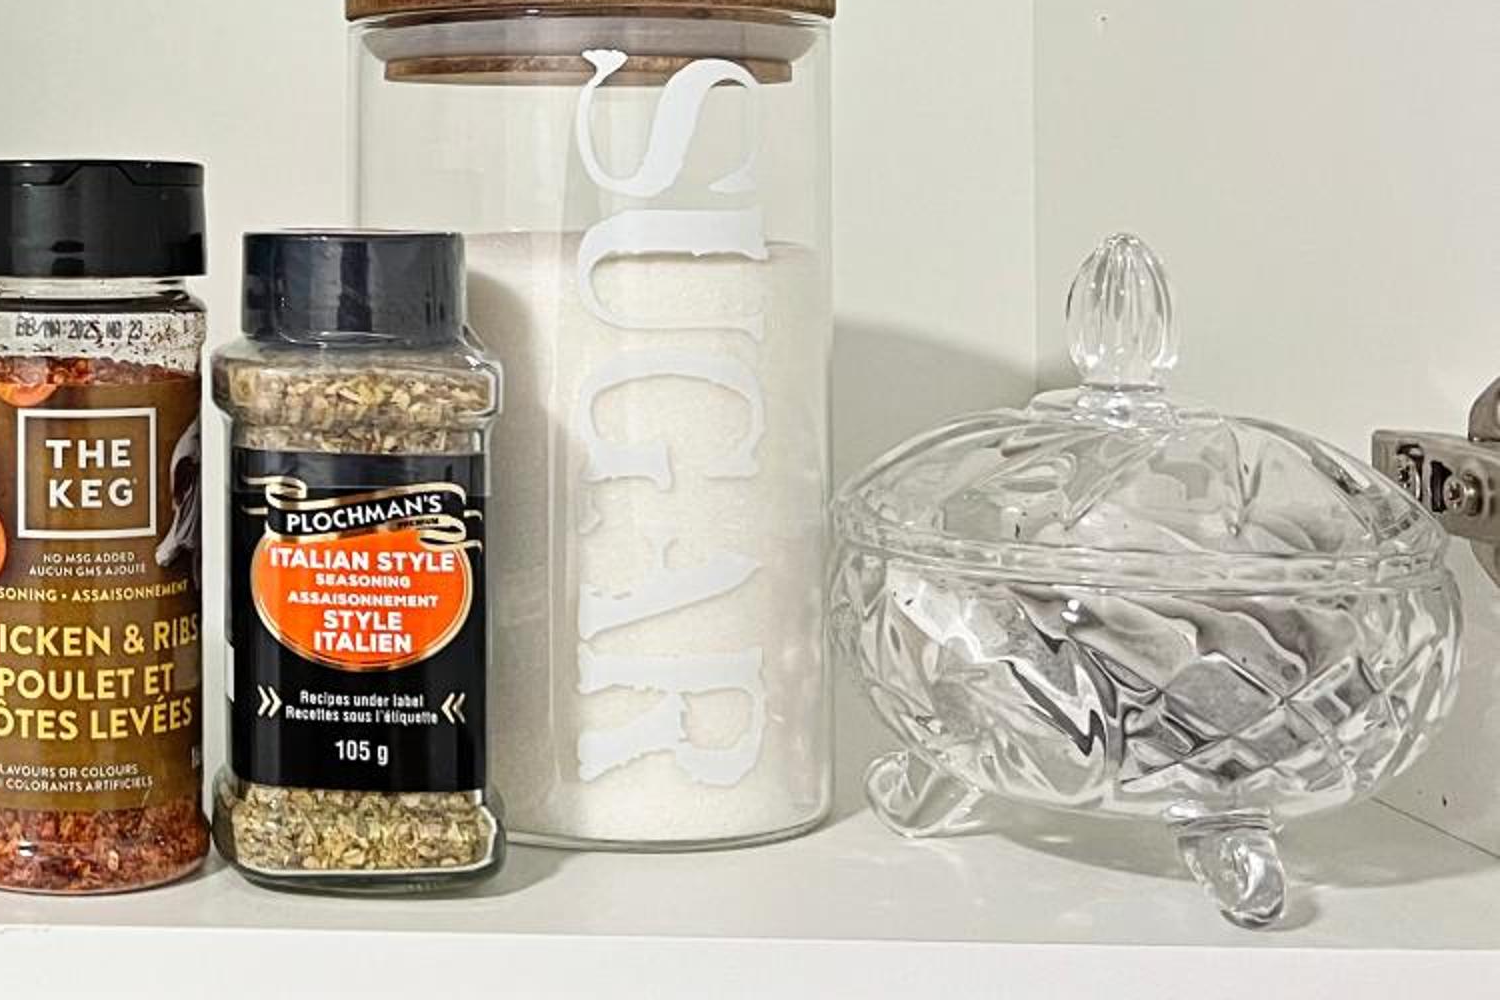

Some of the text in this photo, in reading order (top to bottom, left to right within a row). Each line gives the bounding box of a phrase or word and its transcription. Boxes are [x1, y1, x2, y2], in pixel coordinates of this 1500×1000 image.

[575, 48, 769, 789] SUGAR
[45, 439, 132, 469] THE
[48, 478, 134, 509] KEG
[285, 495, 443, 533] PLOCHMAN'S
[43, 551, 135, 564] NO MSG ADDED
[269, 546, 455, 573] ITALIAN STYLE
[28, 565, 73, 577] AUCUN
[75, 565, 101, 577] GMS
[314, 573, 411, 589] SEASONING
[71, 577, 188, 603] ASSAISONNEMENT
[287, 591, 439, 608] ASSAISONNEMENT
[323, 610, 403, 631] STYLE
[123, 623, 145, 655] &
[153, 613, 199, 651] RIBS
[313, 632, 413, 654] ITALIEN
[144, 663, 175, 696] ET
[299, 689, 424, 708] Recipes under label
[90, 695, 193, 740] LEVÉES
[285, 704, 339, 721] Recettes
[342, 710, 373, 723] sous
[334, 739, 389, 767] 105 g
[58, 766, 77, 779] OR
[80, 763, 139, 779] COLOURS
[5, 777, 82, 792] COLORANTS
[84, 775, 154, 792] ARTIFICIELS
